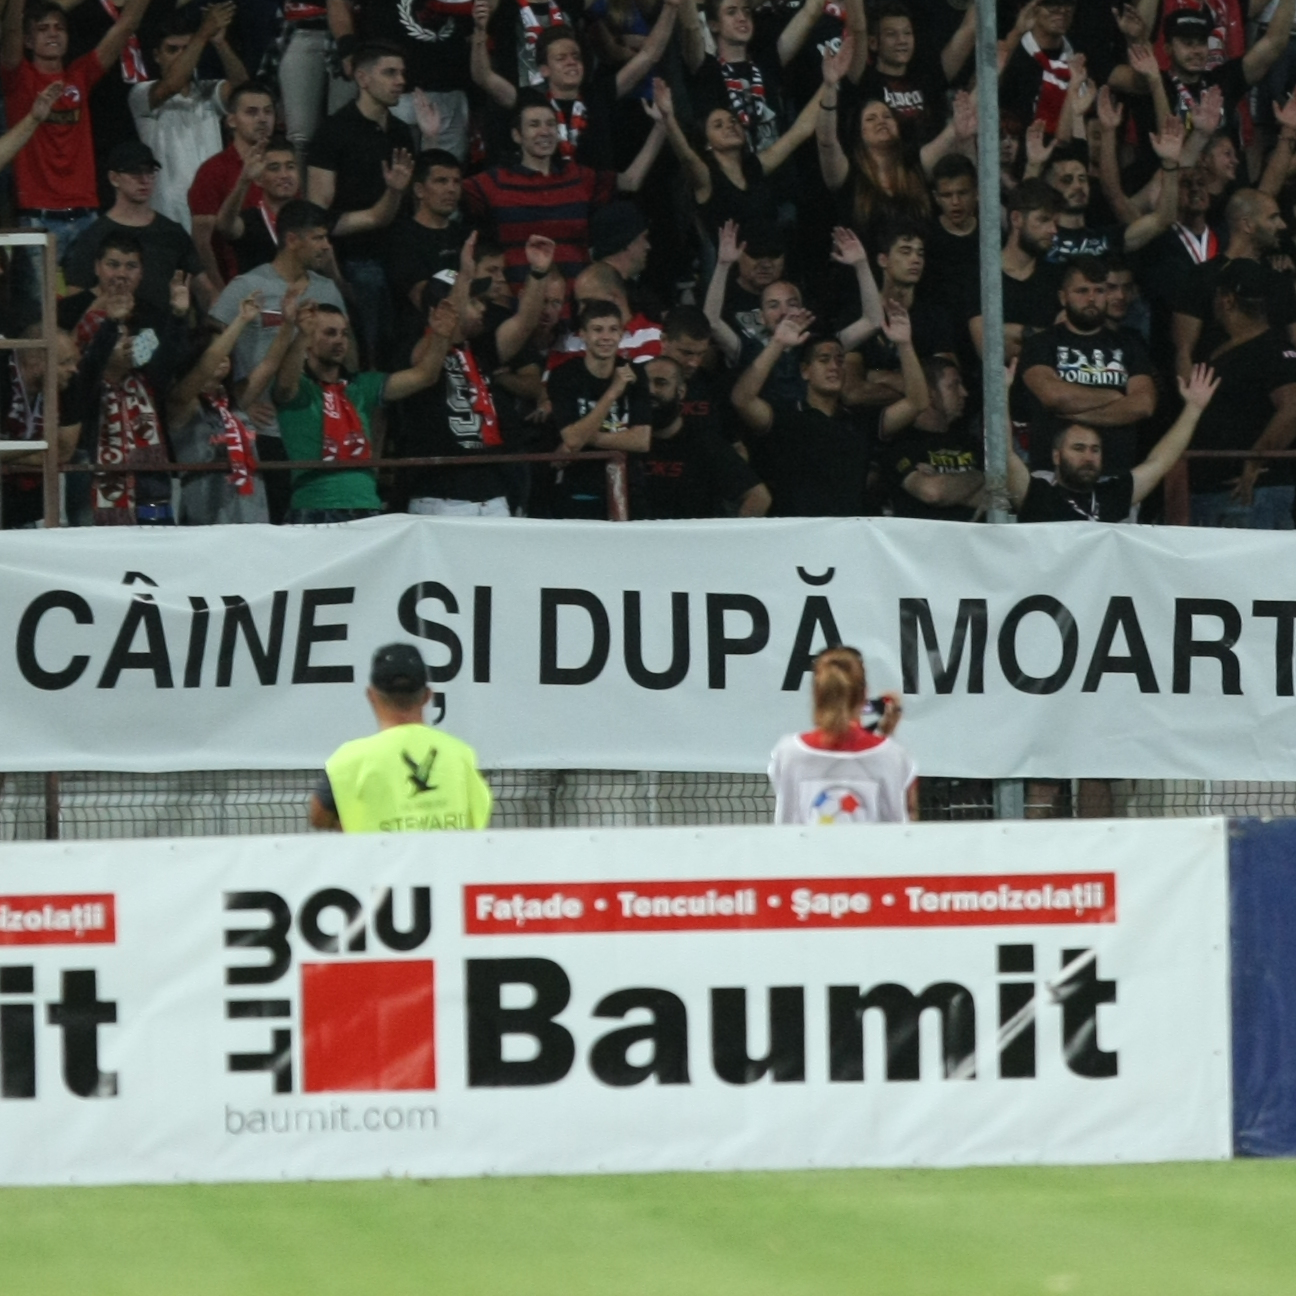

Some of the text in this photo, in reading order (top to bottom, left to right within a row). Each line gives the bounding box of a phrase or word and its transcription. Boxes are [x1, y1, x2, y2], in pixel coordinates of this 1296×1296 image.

[15, 570, 356, 691] CÂINE
[397, 580, 493, 724] ȘI
[538, 566, 850, 692] DUPĂ
[617, 888, 757, 918] Tencuieli
[464, 942, 1119, 1089] Baumit
[224, 1101, 439, 1135] baumit.com
